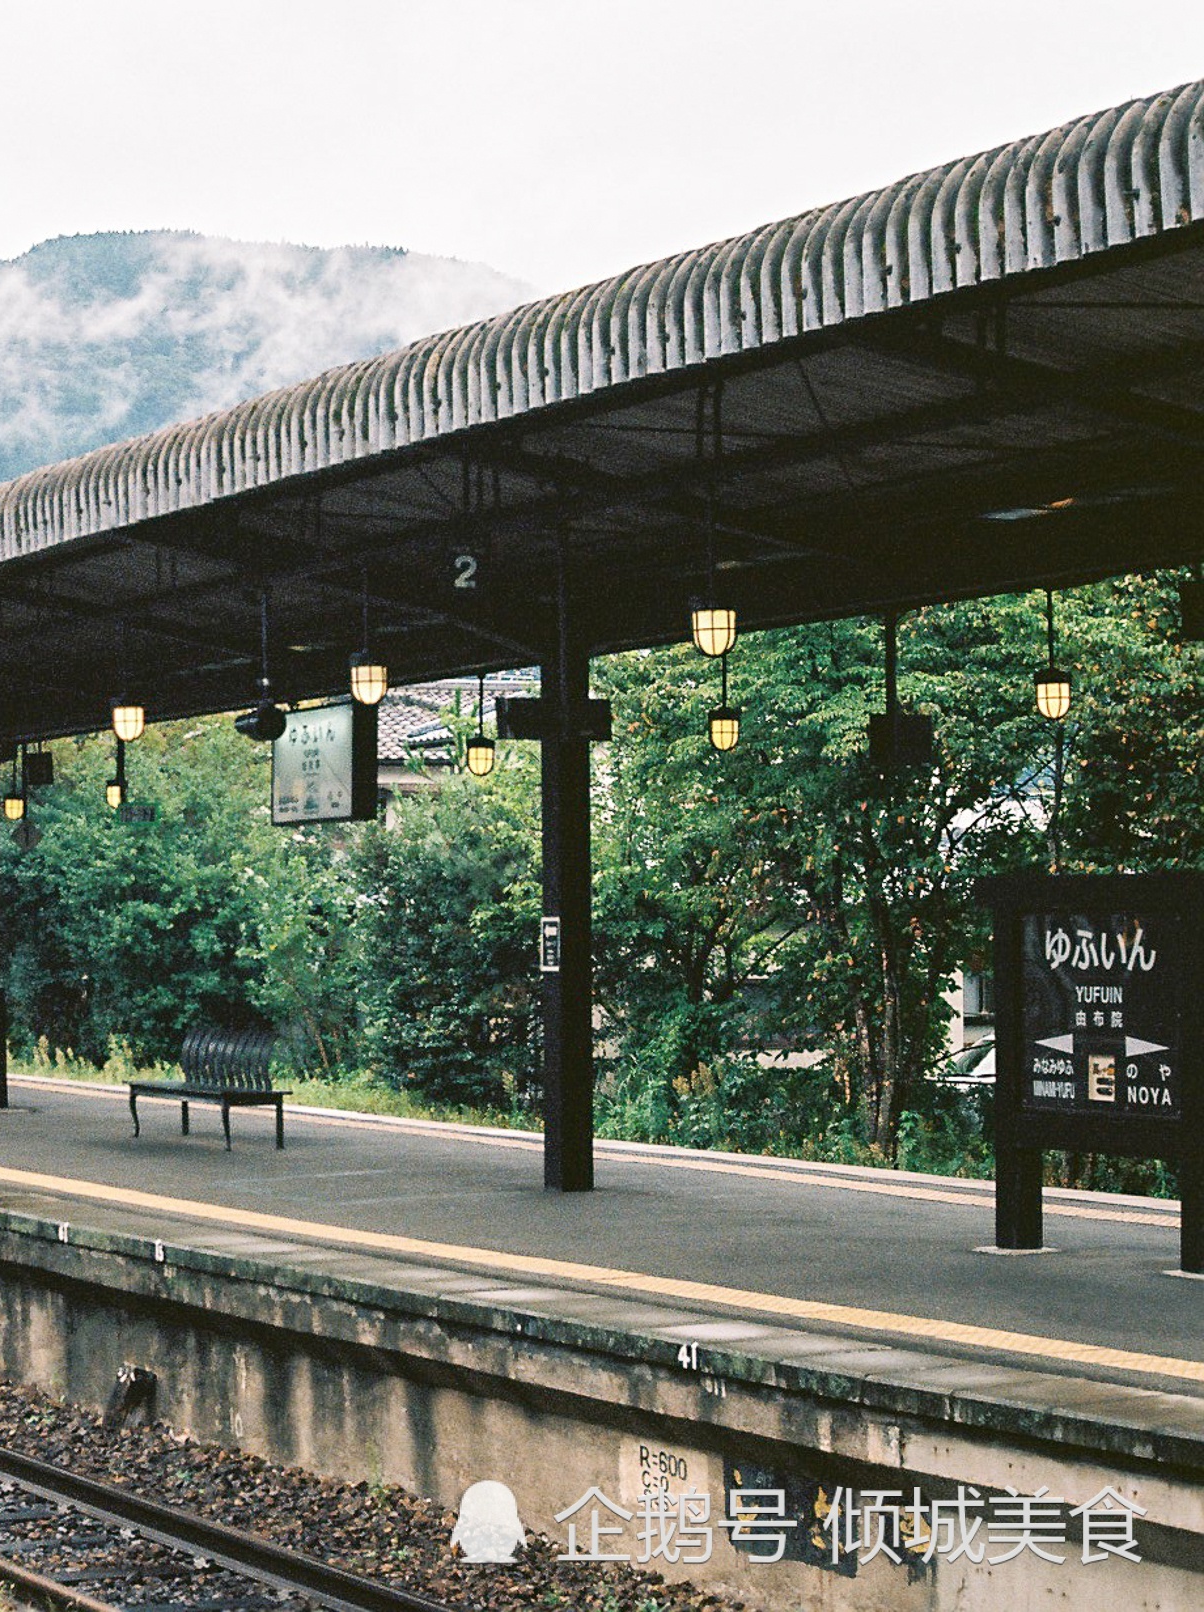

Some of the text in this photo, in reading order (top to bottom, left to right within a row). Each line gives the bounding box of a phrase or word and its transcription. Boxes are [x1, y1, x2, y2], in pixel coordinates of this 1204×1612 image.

[454, 555, 477, 588] 2
[1045, 927, 1157, 972] ゆふいん
[1075, 986, 1124, 1004] YUFUIN
[1075, 1009, 1124, 1029] 由布院
[1127, 1085, 1173, 1107] NOYA
[639, 1445, 688, 1481] R=600
